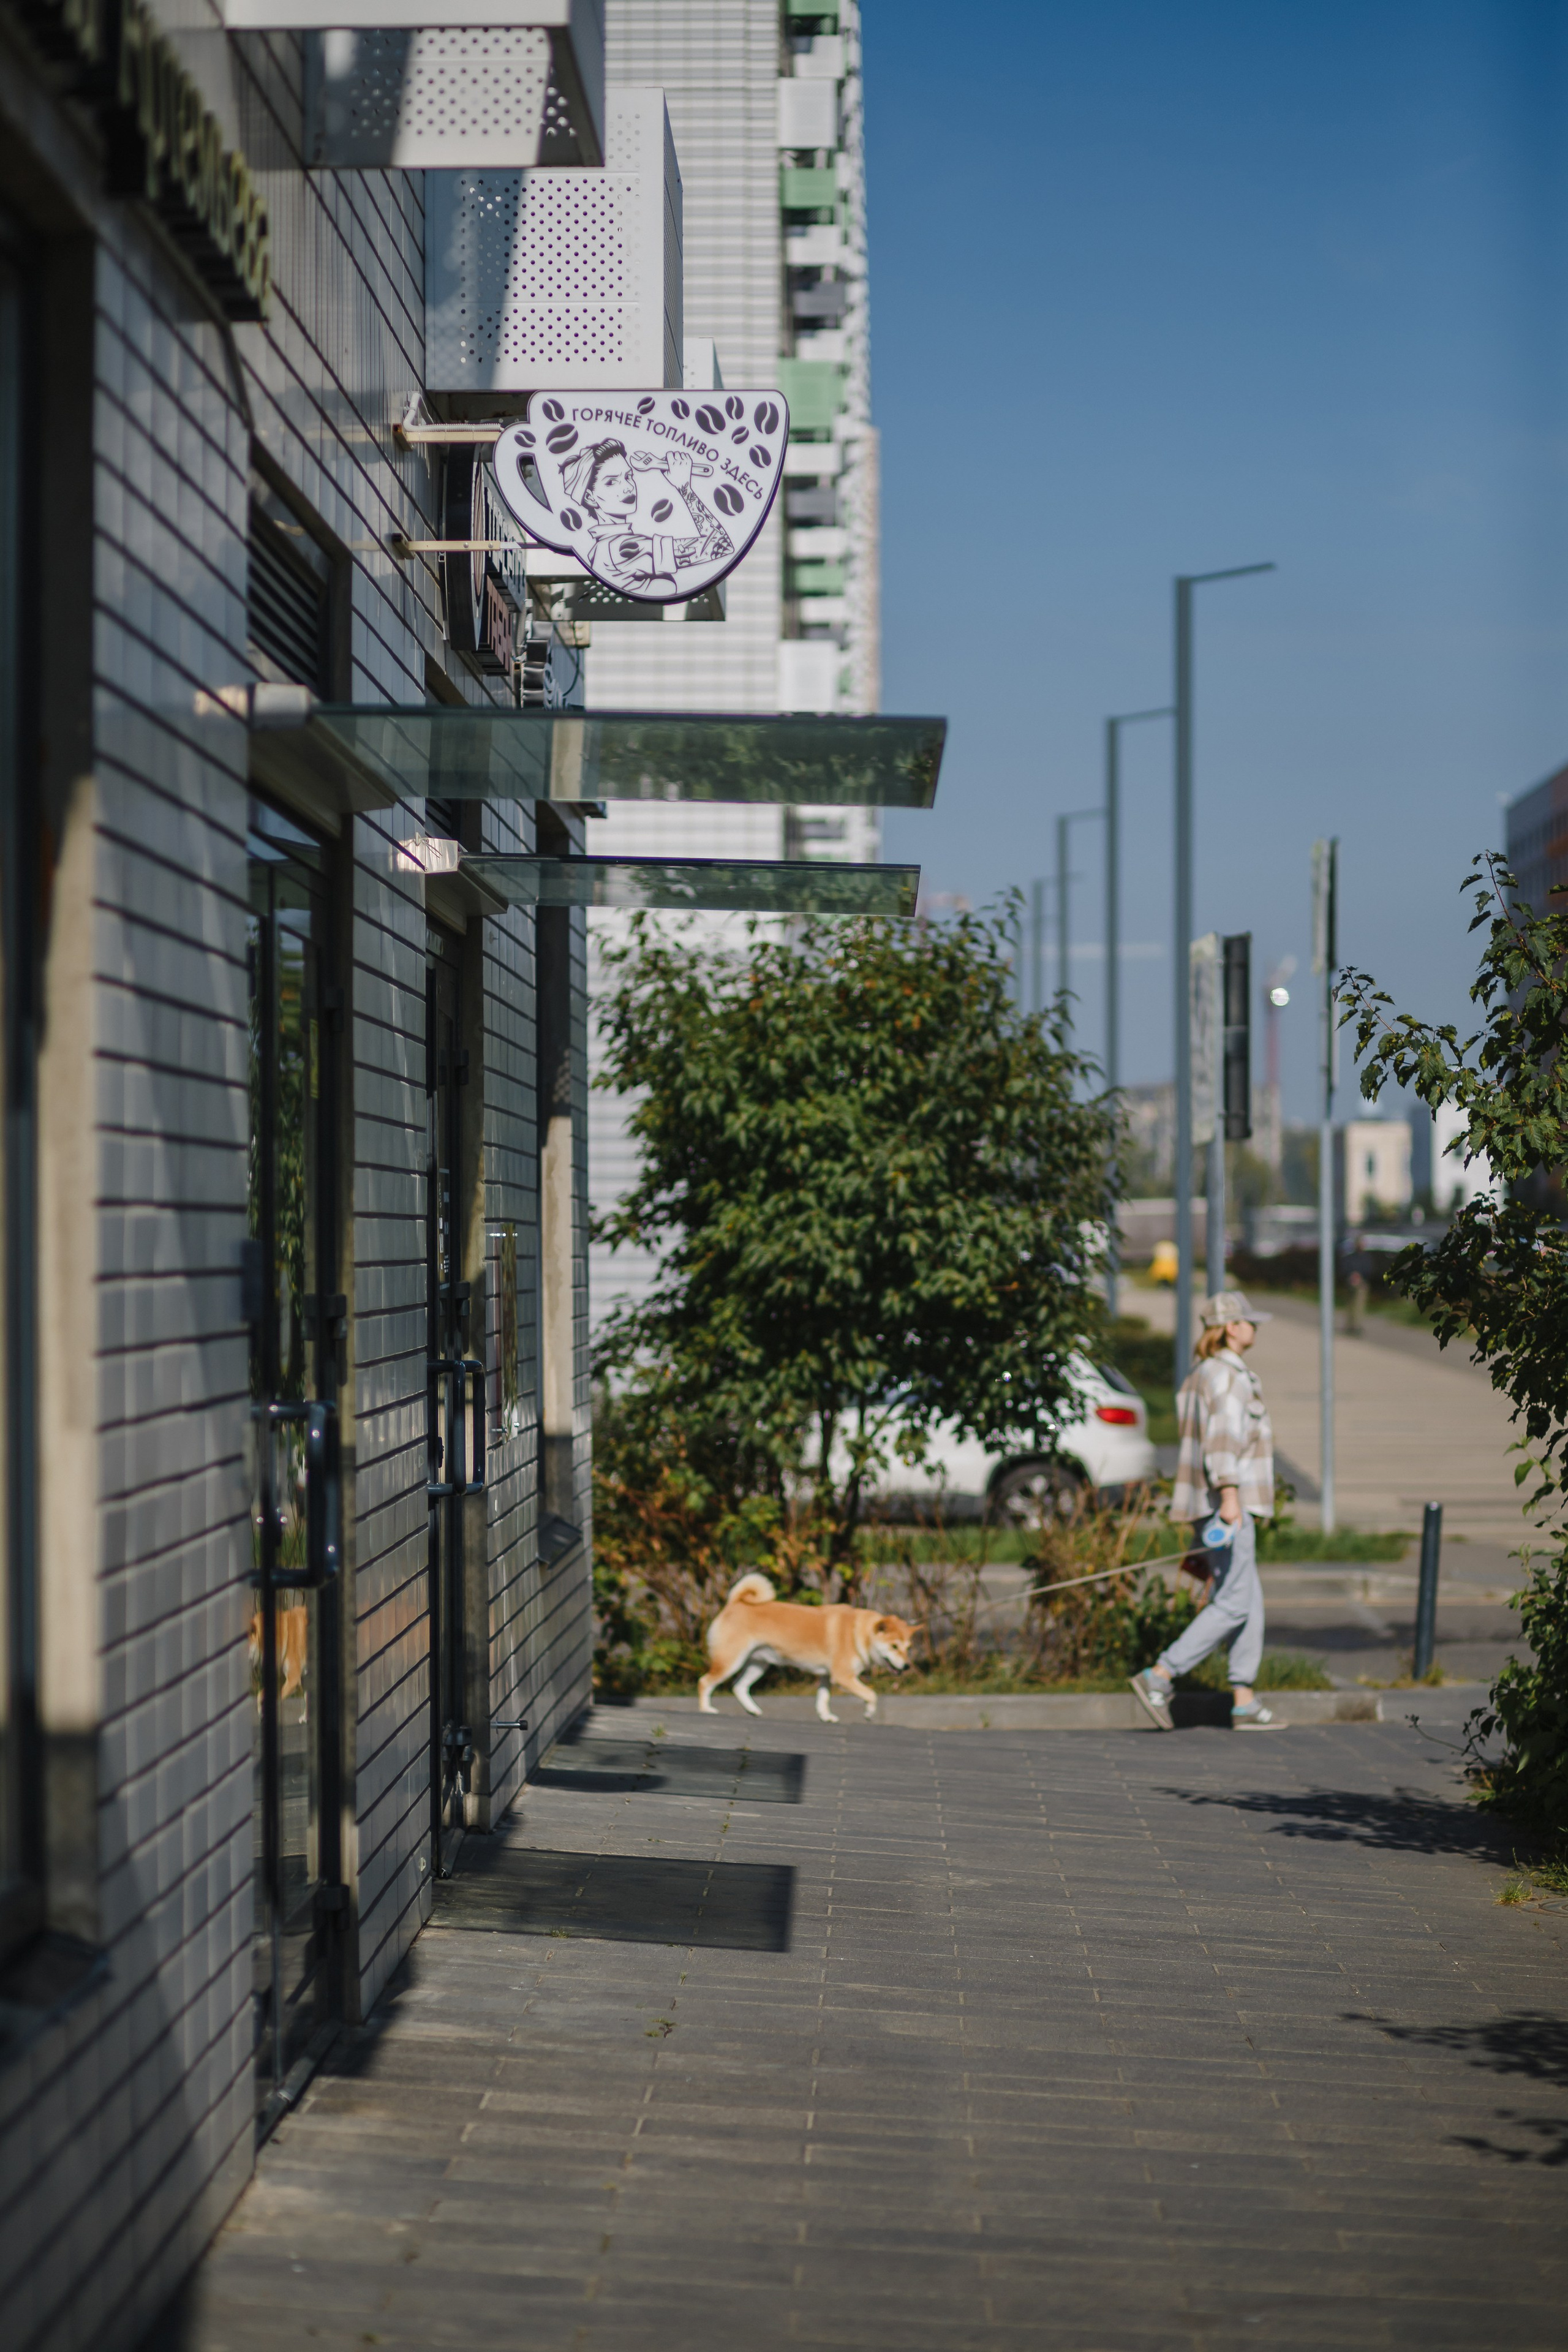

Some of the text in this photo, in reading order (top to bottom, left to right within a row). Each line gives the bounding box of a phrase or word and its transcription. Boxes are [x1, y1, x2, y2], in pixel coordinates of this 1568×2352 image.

[572, 407, 763, 500] ГОРЯЧЕЕ ТОПЛИВО ЗДЕСЬ
